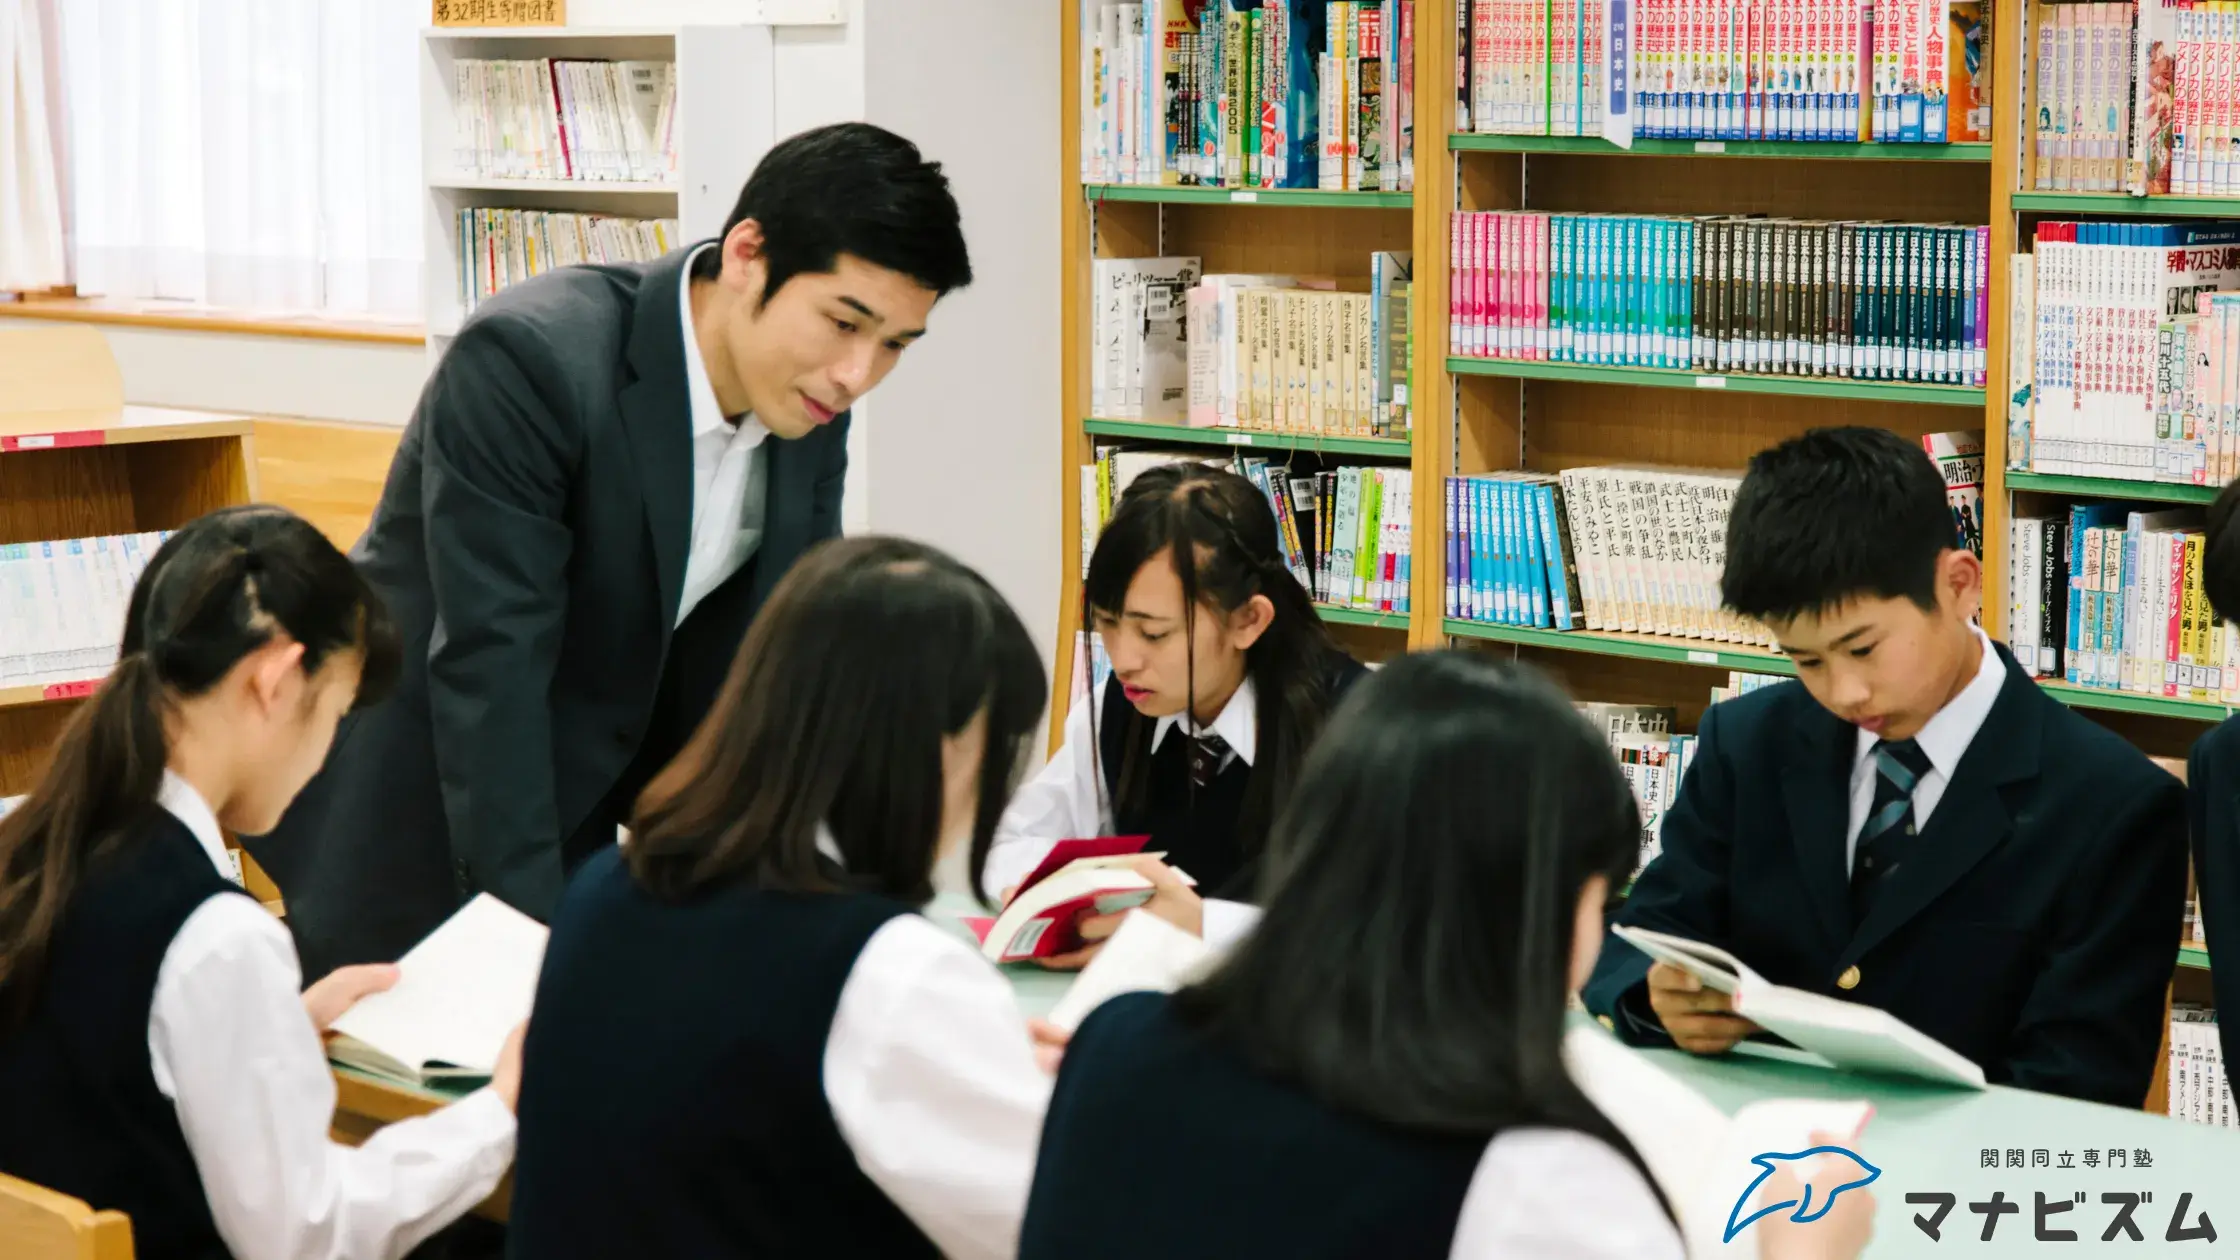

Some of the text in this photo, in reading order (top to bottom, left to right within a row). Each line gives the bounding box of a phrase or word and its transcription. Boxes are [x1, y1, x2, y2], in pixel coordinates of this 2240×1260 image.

[1614, 38, 1623, 92] 日本史
[2174, 42, 2188, 124] アメリカの歴史
[2188, 44, 2201, 126] アメリカの歴史
[2203, 43, 2216, 125] アメリカの歴史
[2217, 44, 2231, 126] アメリカの歴史
[2145, 310, 2157, 410] 学問・マスコミ人物事典
[2159, 330, 2172, 393] 徳川十五代
[1563, 476, 1582, 554] 日本たんじょう
[1580, 478, 1600, 556] 平安のみやこ
[1596, 479, 1619, 557] 源氏と平氏
[1613, 479, 1636, 557] 土一揆と町衆
[1629, 481, 1654, 559] 戦国の争乱
[1644, 482, 1668, 561] 鎖国の世のなか
[1660, 482, 1684, 562] 武士と農民
[1674, 482, 1698, 560] 武士と町人
[1688, 486, 1711, 565] 近代日本の夜あけ
[1703, 486, 1727, 565] 明治維新
[2022, 524, 2032, 577] Steve Jobs
[2045, 524, 2055, 578] Steve Jobs
[2168, 543, 2183, 620] マッサンとリタ
[2182, 541, 2196, 630] 月のえくぼを見た男
[1641, 769, 1659, 848] 日本史モノ事
